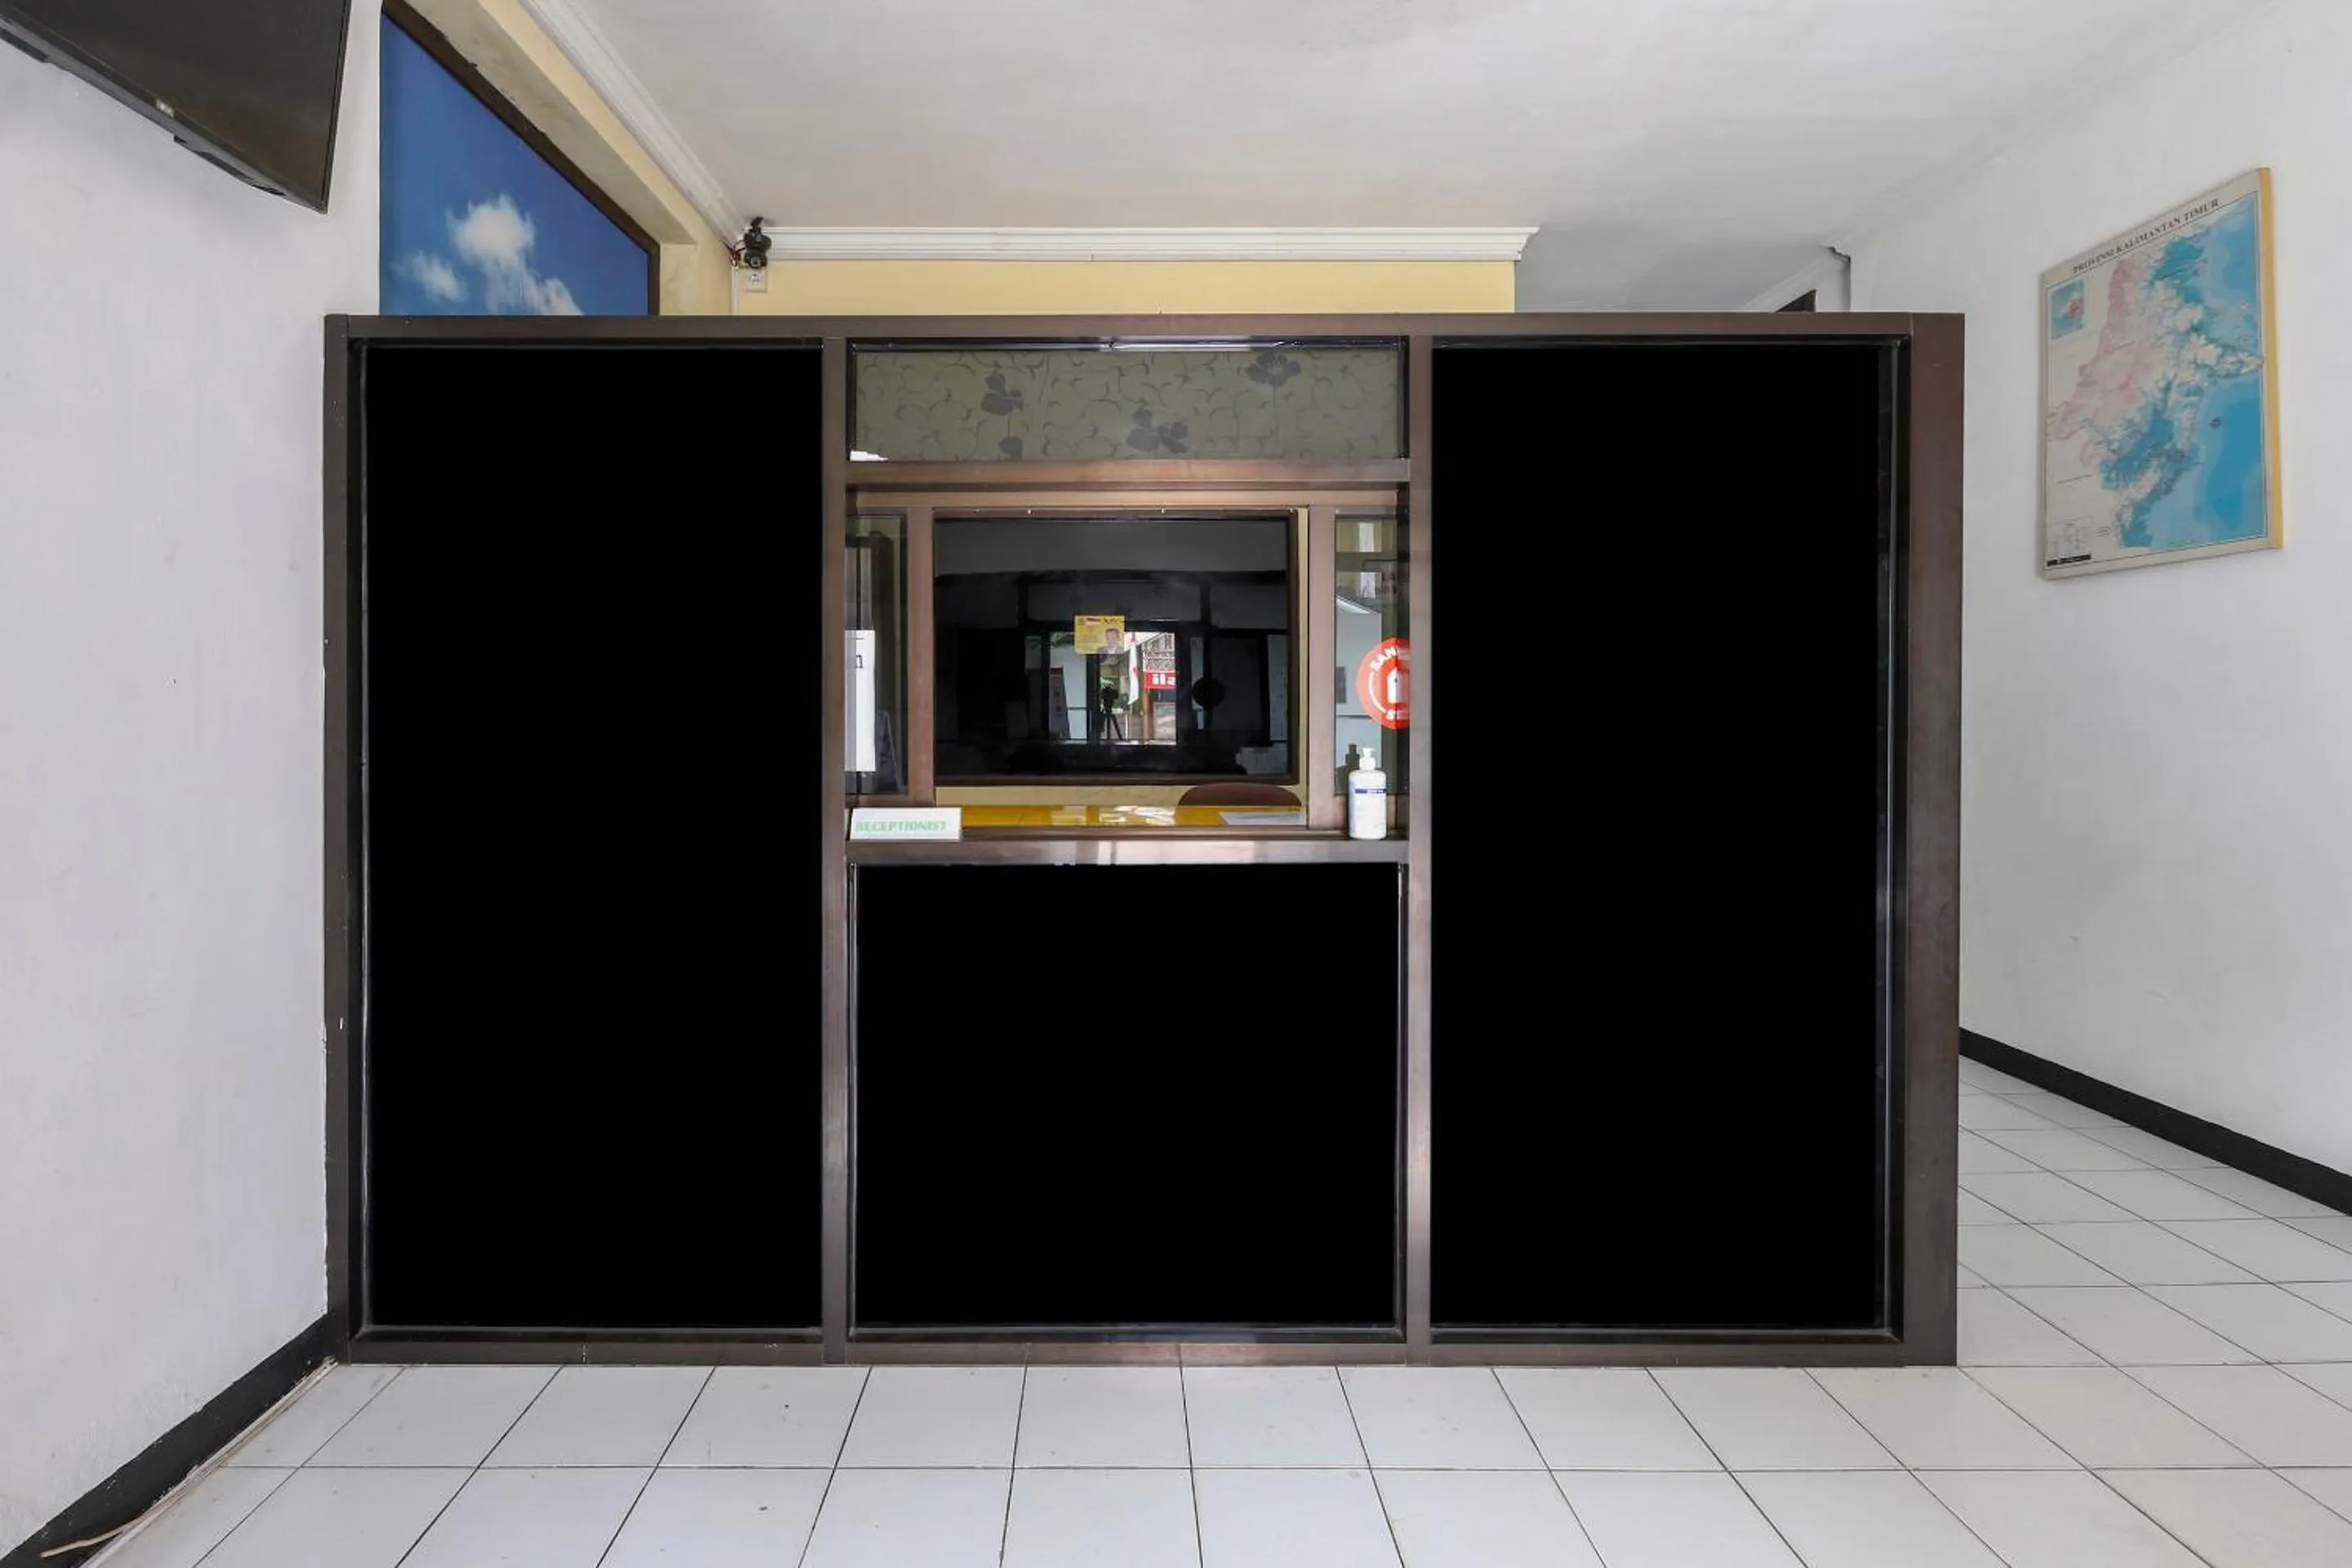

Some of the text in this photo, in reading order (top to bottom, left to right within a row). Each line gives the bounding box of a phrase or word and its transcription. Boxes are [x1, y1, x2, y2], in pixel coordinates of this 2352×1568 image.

[2115, 216, 2180, 253] KALIMANTAN
[2184, 198, 2219, 222] TIMUR
[855, 820, 947, 832] RECEPTIONIST
